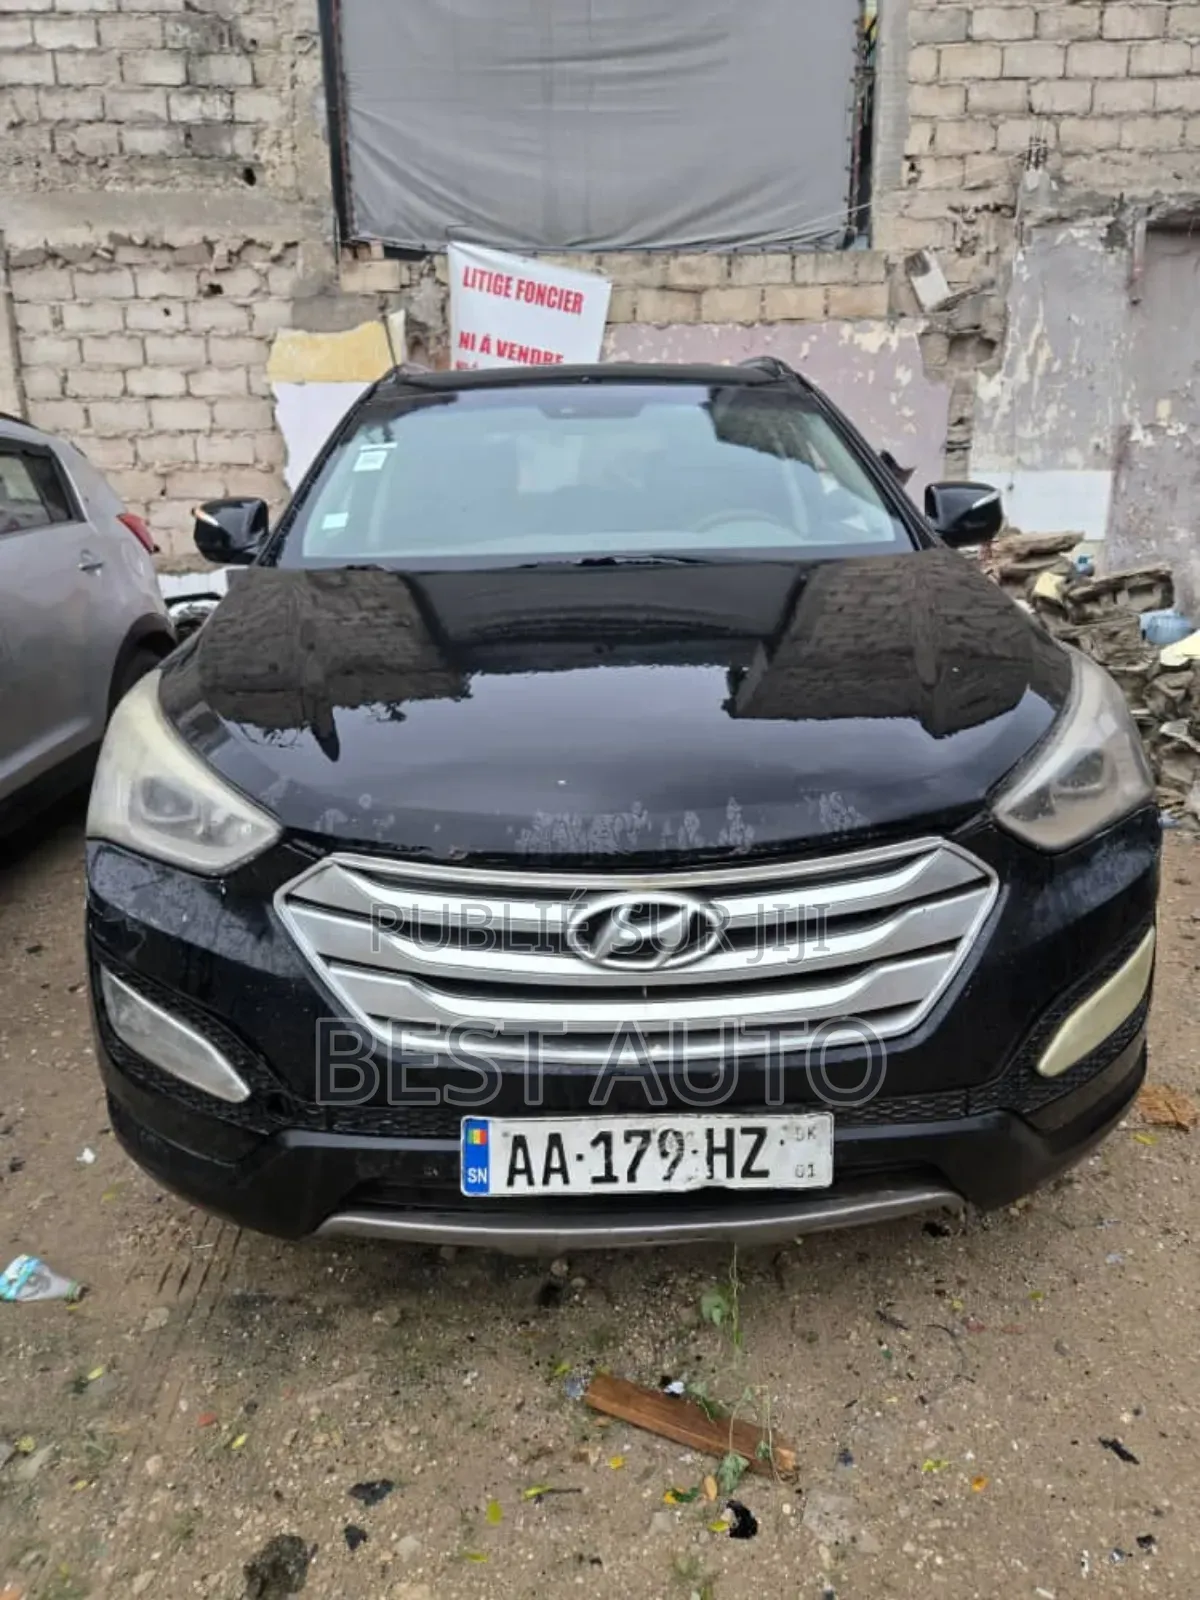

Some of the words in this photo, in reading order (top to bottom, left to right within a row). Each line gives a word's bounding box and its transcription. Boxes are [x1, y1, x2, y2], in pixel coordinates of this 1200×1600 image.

[463, 266, 513, 297] LITIGE
[515, 279, 585, 315] FONCIER
[458, 331, 476, 351] NI
[496, 338, 564, 365] VENDRE
[467, 1167, 488, 1184] SN
